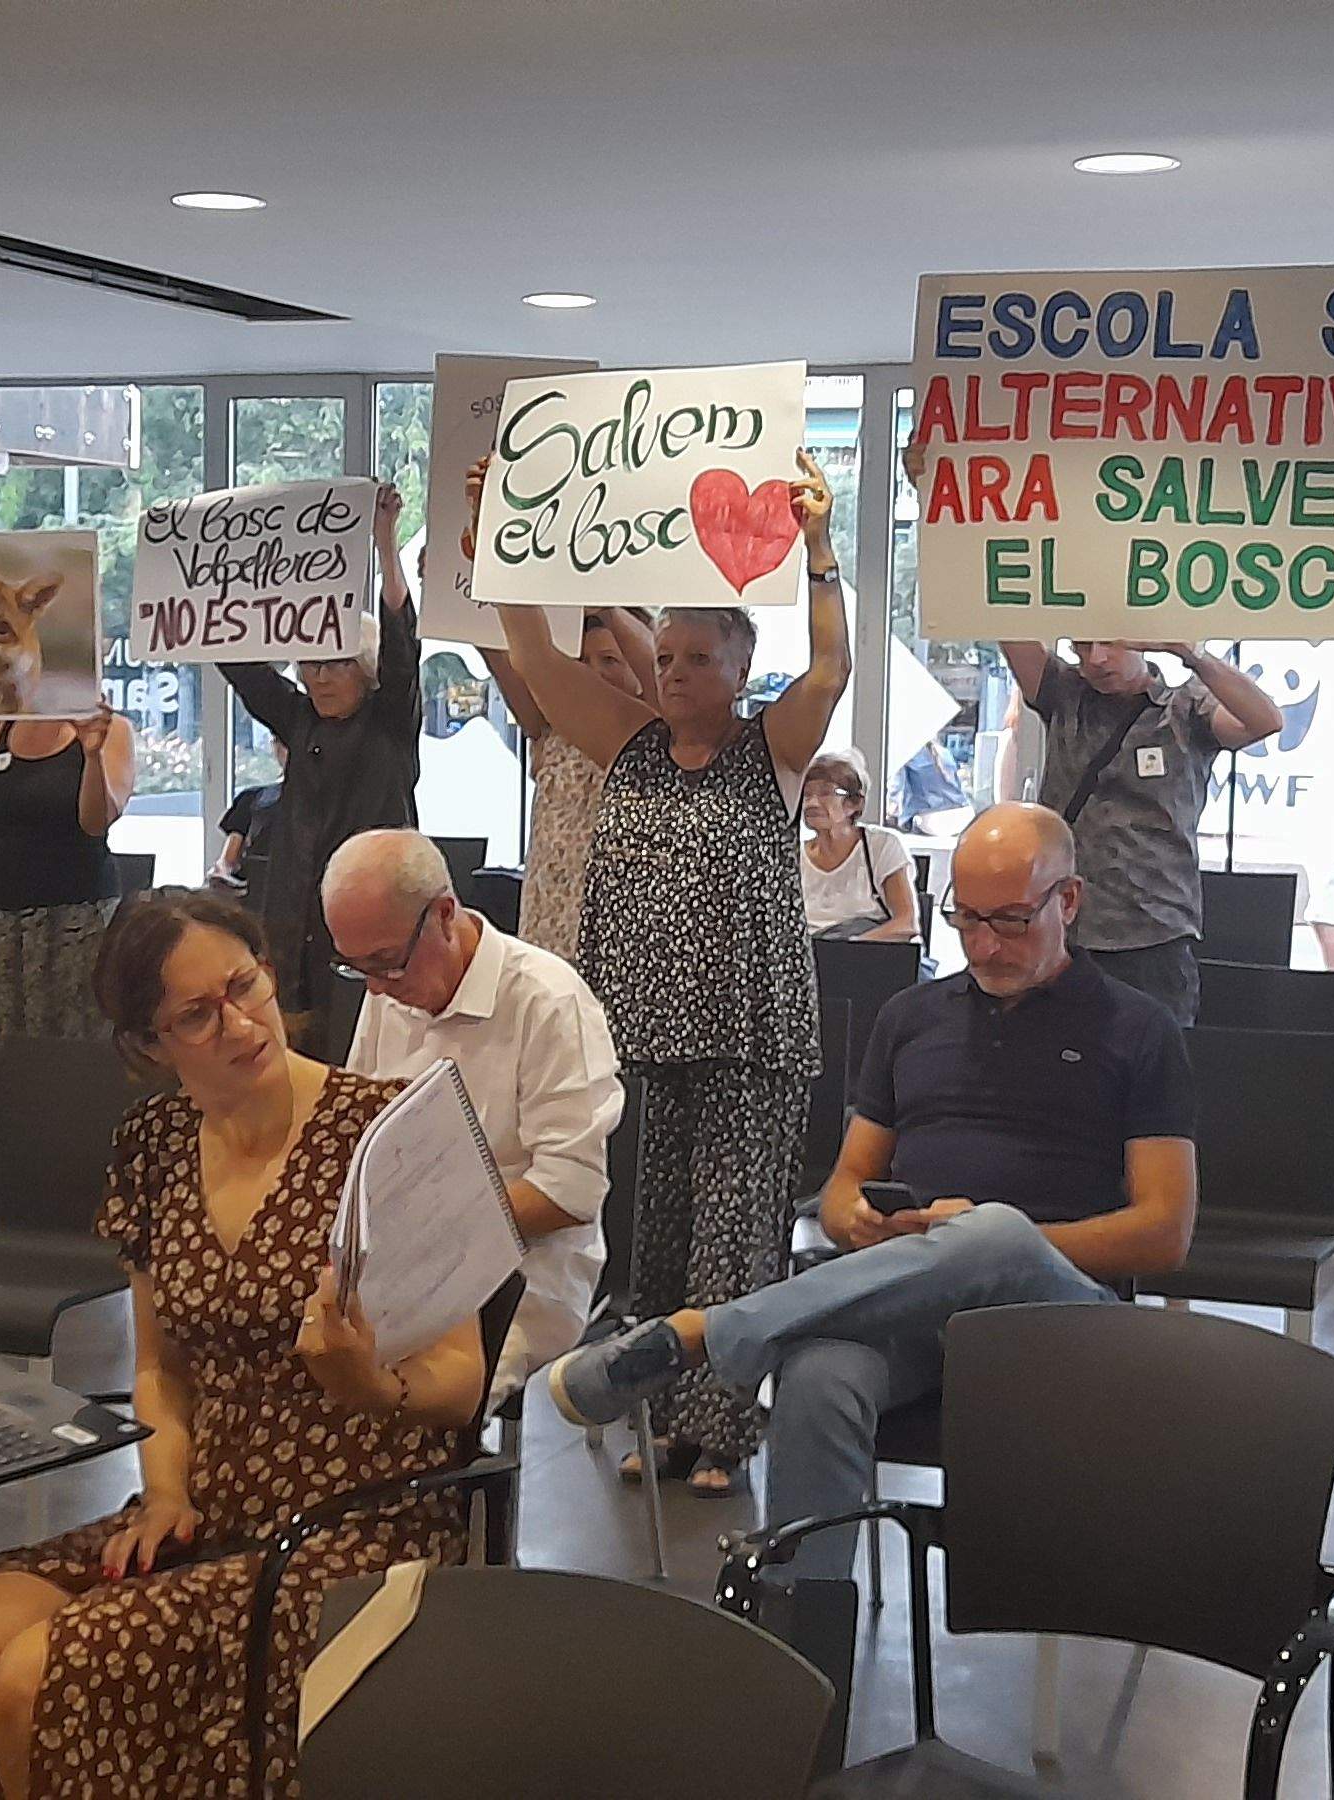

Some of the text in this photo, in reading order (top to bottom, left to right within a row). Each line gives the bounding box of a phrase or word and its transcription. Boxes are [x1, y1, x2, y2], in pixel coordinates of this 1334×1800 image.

[935, 290, 1260, 360] ESCOLA
[499, 378, 764, 511] Salvem
[200, 496, 286, 543] bosc
[296, 488, 362, 535] de
[926, 454, 1059, 523] ARA
[493, 481, 693, 573] el bosc
[985, 538, 1086, 606] EL
[139, 592, 355, 651] "NO ES TOCA"
